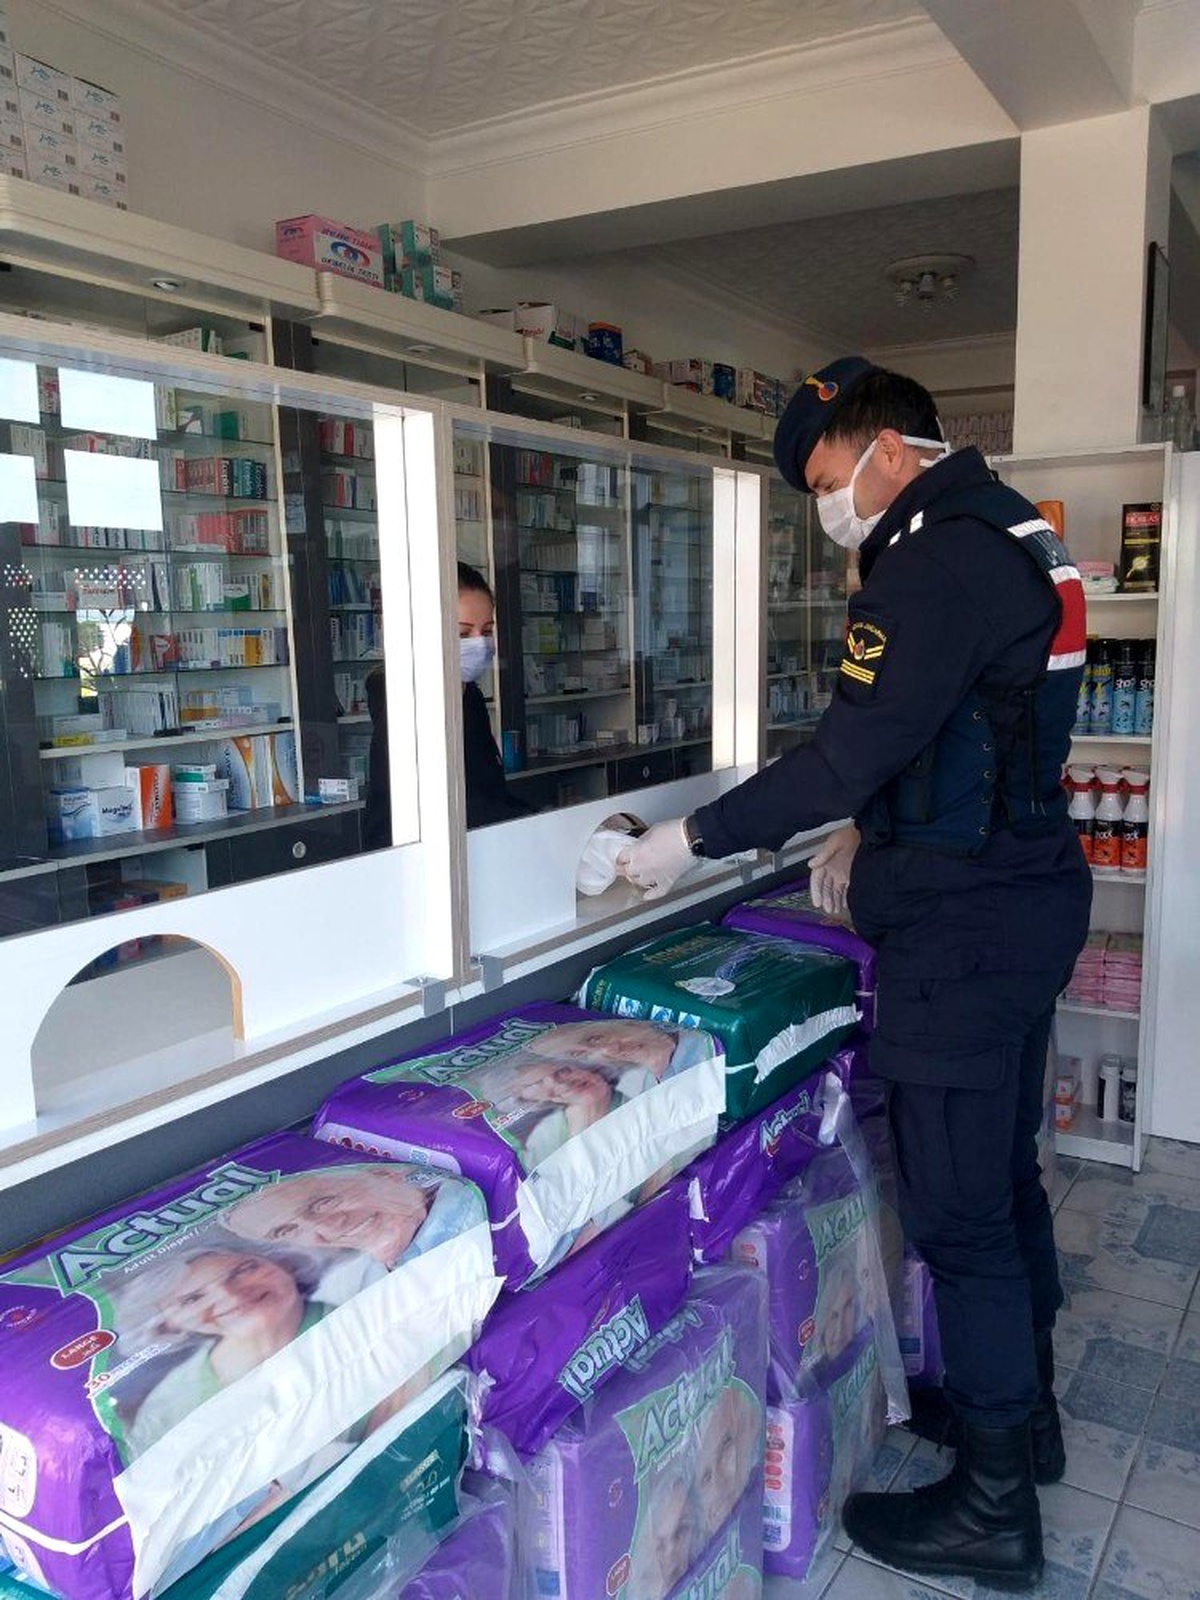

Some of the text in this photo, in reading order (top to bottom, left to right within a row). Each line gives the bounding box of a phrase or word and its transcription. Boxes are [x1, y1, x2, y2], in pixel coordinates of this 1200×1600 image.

[418, 1019, 552, 1083] Actual
[56, 1166, 272, 1288] Actual
[562, 1299, 649, 1398] Actual
[637, 1330, 735, 1473] Actual
